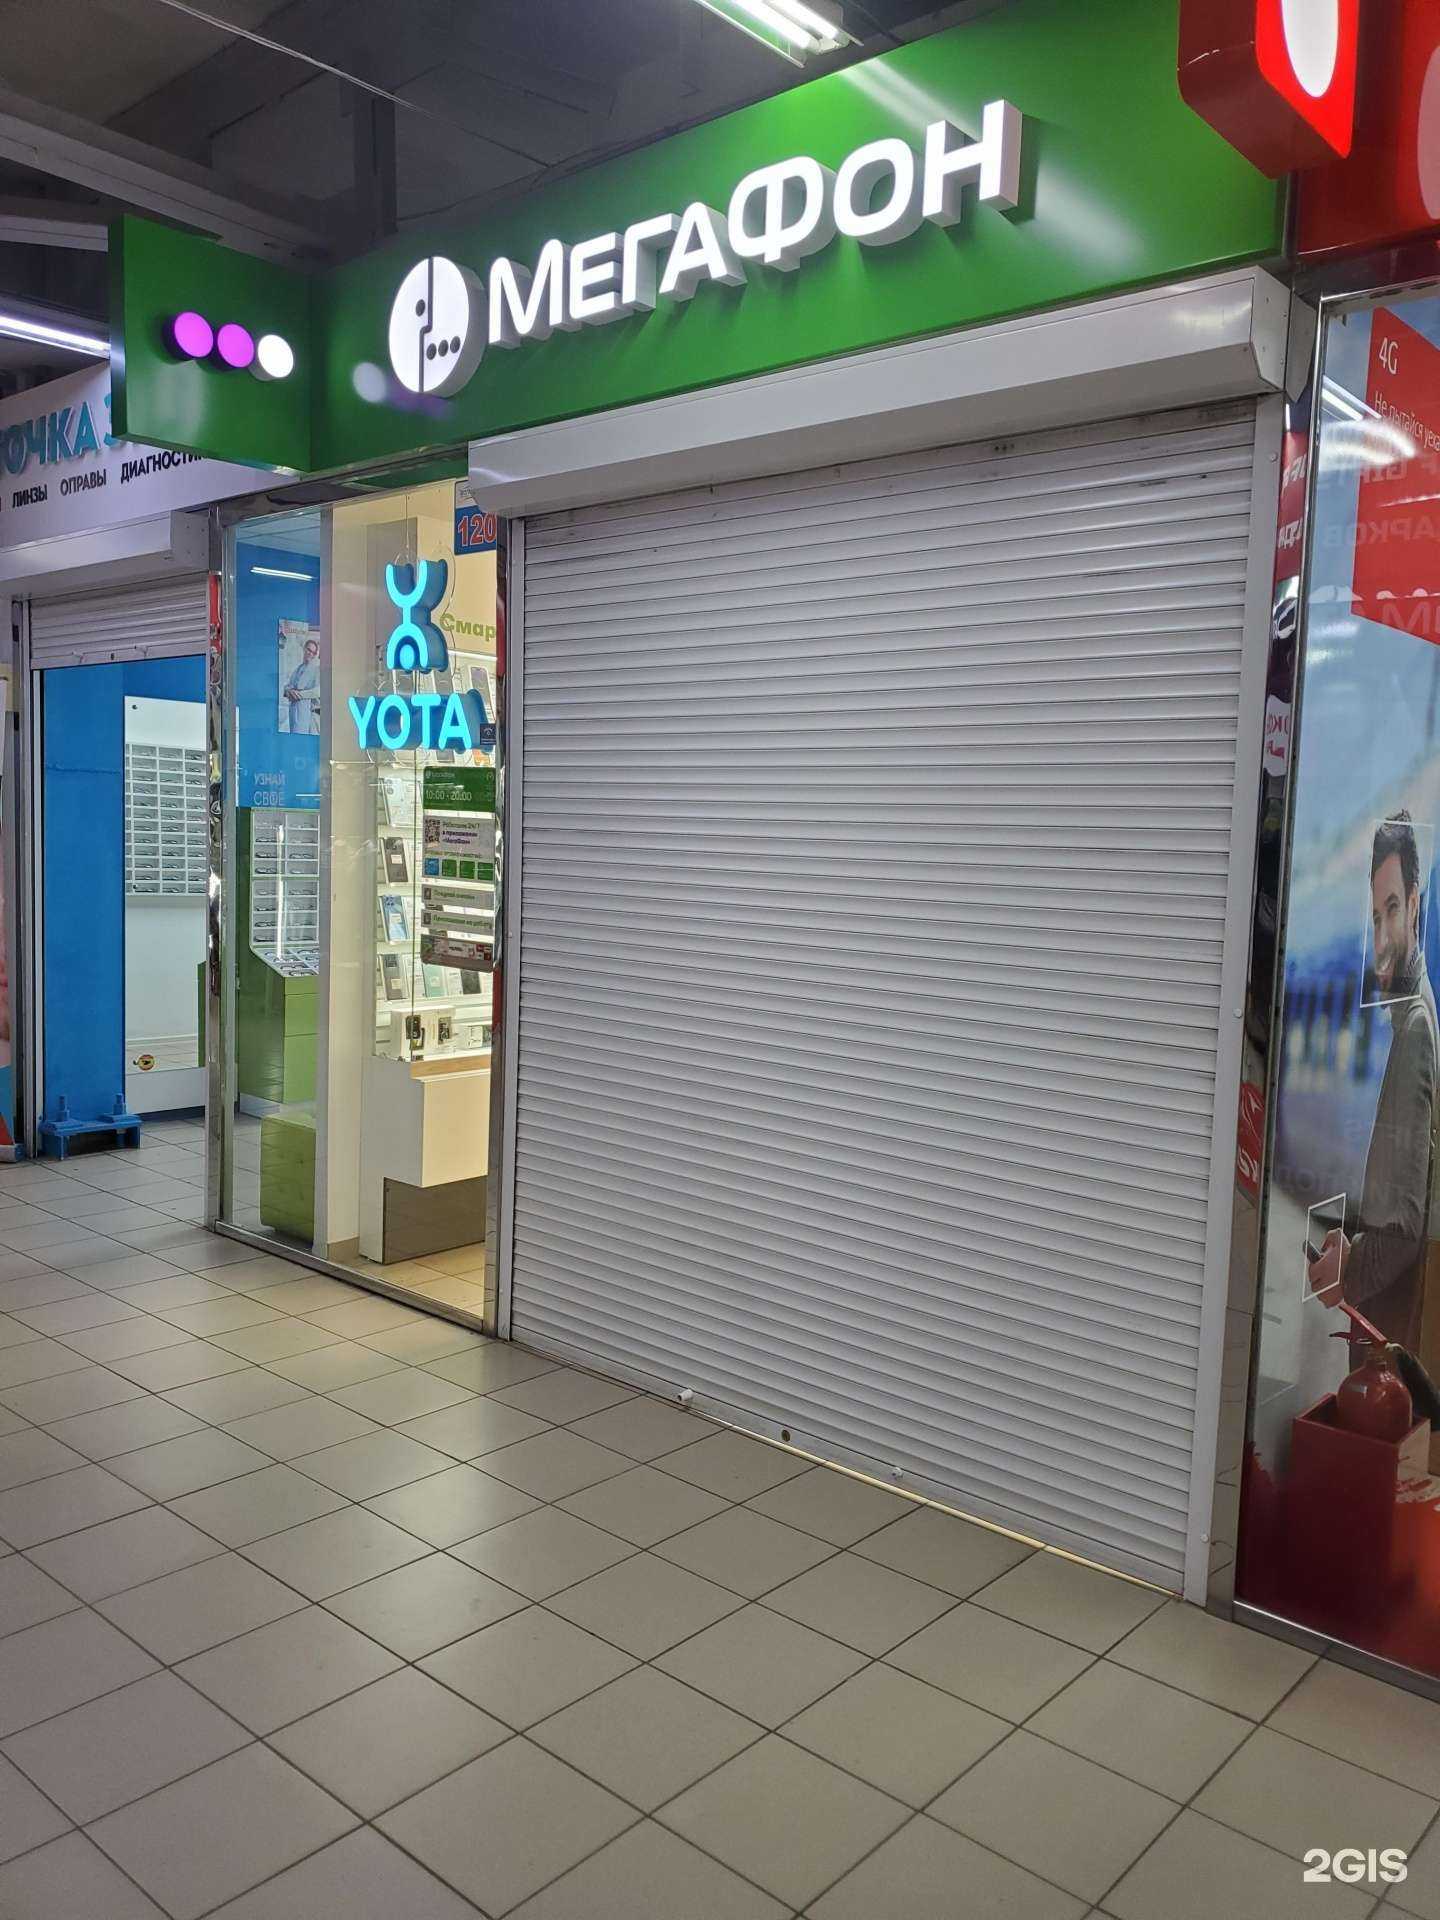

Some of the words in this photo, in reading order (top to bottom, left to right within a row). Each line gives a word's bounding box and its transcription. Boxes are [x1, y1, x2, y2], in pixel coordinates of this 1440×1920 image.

[488, 99, 1022, 348] МЕГАФОН
[1379, 337, 1398, 375] 4G
[1375, 391, 1388, 417] Не
[0, 400, 101, 475] ОЧКА
[12, 484, 48, 508] ЛИНЗЫ
[60, 468, 107, 496] ОПРАВЫ
[457, 512, 497, 547] 120
[347, 692, 472, 750] YOTA
[254, 770, 285, 786] УЗНАЙ
